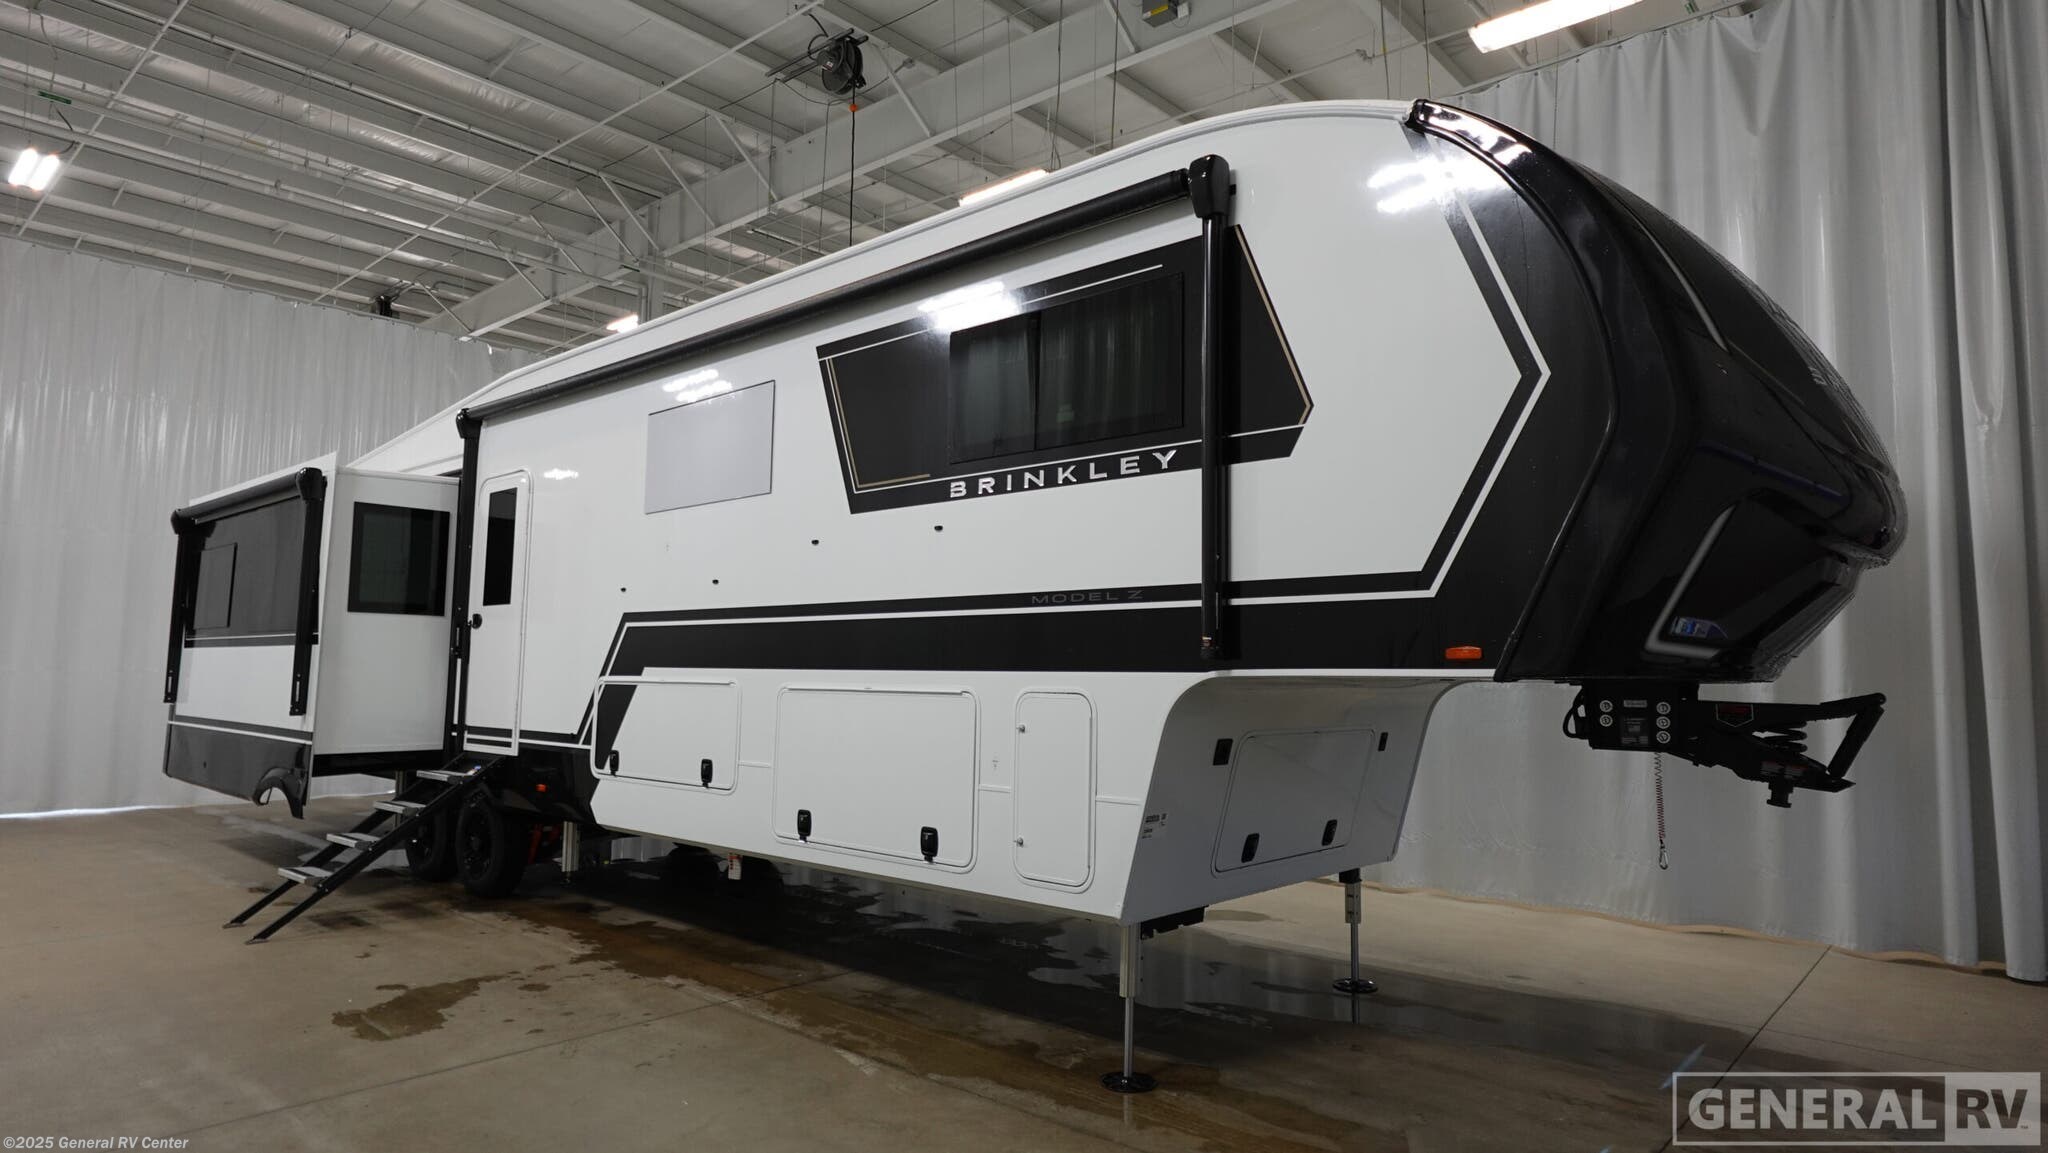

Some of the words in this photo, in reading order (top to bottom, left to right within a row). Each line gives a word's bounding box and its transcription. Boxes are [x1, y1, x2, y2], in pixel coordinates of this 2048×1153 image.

[949, 449, 1178, 498] BRINKLEY
[1031, 591, 1118, 605] MODEL
[1127, 590, 1144, 600] Z
